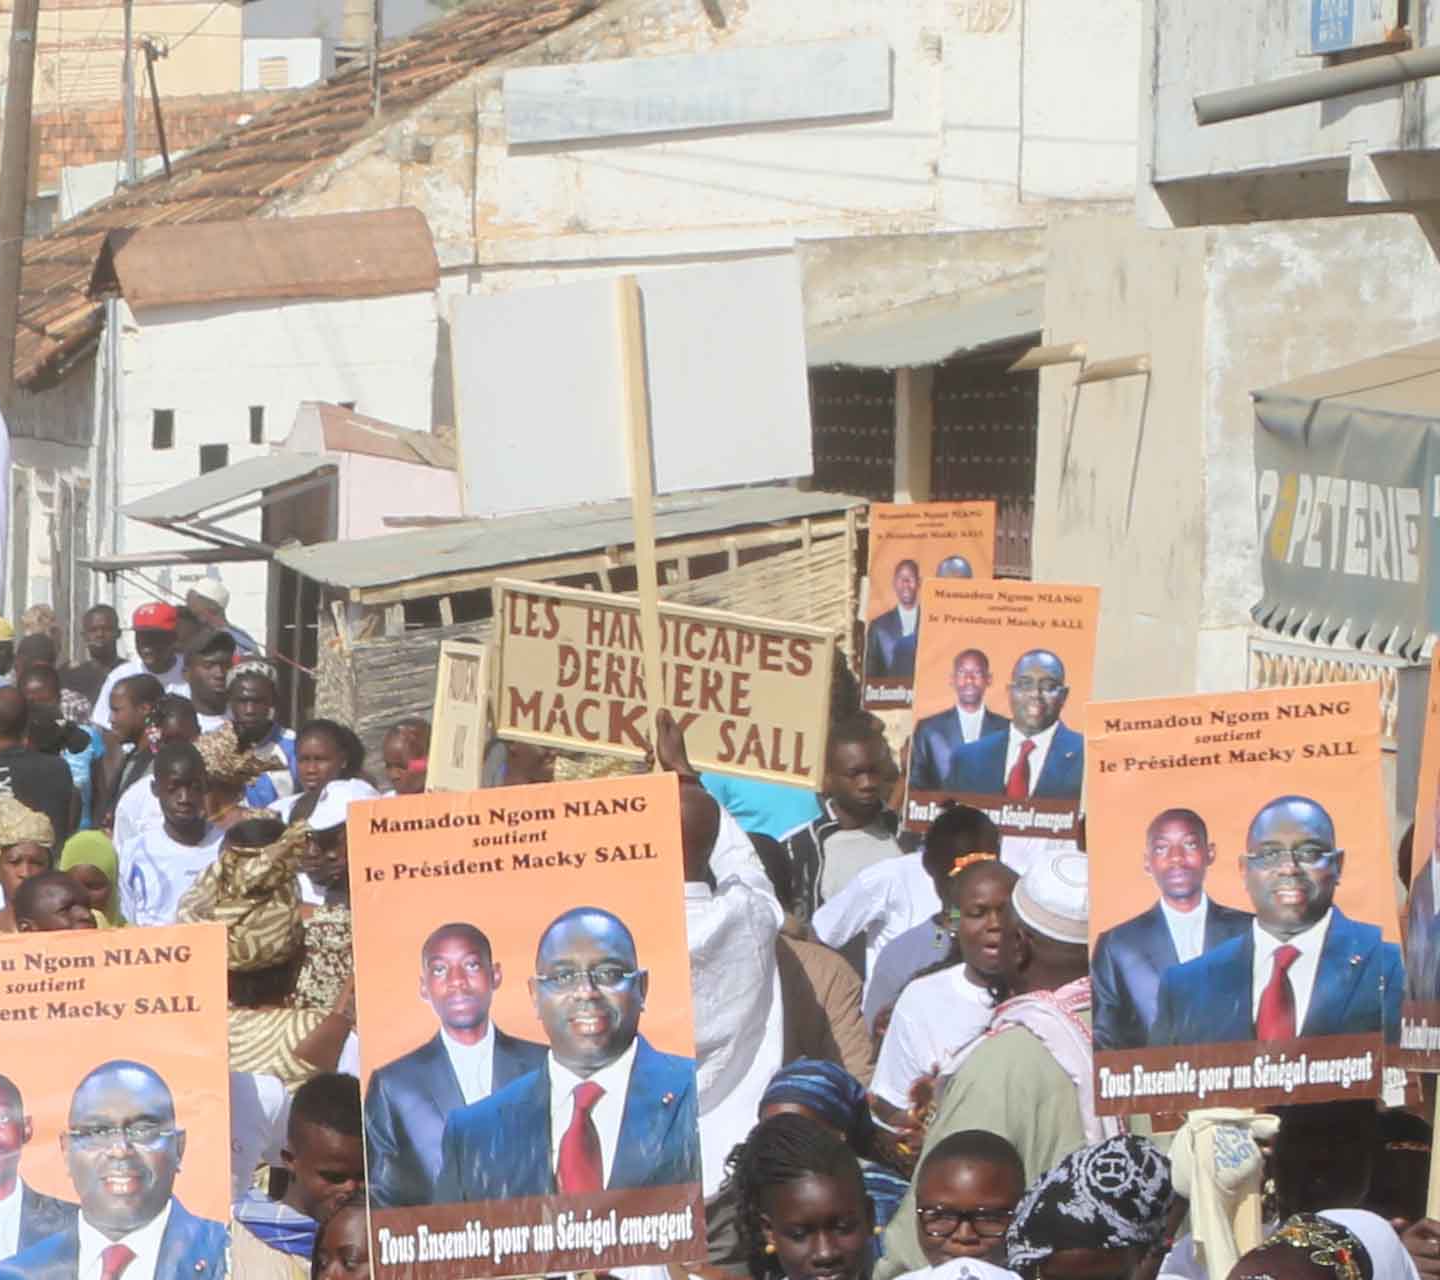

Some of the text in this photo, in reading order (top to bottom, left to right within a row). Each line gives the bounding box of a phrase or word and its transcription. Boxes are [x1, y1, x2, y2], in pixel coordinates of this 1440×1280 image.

[508, 594, 561, 640] LES
[1103, 700, 1351, 735] Mamadou Ngom NIANG
[716, 719, 812, 777] SALL
[1194, 728, 1263, 745] soutient
[1098, 740, 1360, 774] le Président Macky SALL
[369, 796, 648, 836] Mamadou Ngom NIANG
[471, 828, 548, 849] soutient
[364, 842, 659, 883] le Président Macky SALL
[23, 951, 96, 976] Ngom
[102, 943, 193, 967] NIANG
[5, 976, 87, 996] soutient
[46, 998, 126, 1022] Macky
[133, 994, 202, 1016] SALL
[1099, 1065, 1132, 1099] Tous
[1133, 1061, 1196, 1097] Ensemble
[1197, 1065, 1231, 1099] pour
[1233, 1064, 1252, 1088] un
[1253, 1052, 1308, 1092] Sénégal
[1308, 1051, 1373, 1089] emergent
[378, 1206, 694, 1267] Tous Ensemble pour un Sénégal emergent
